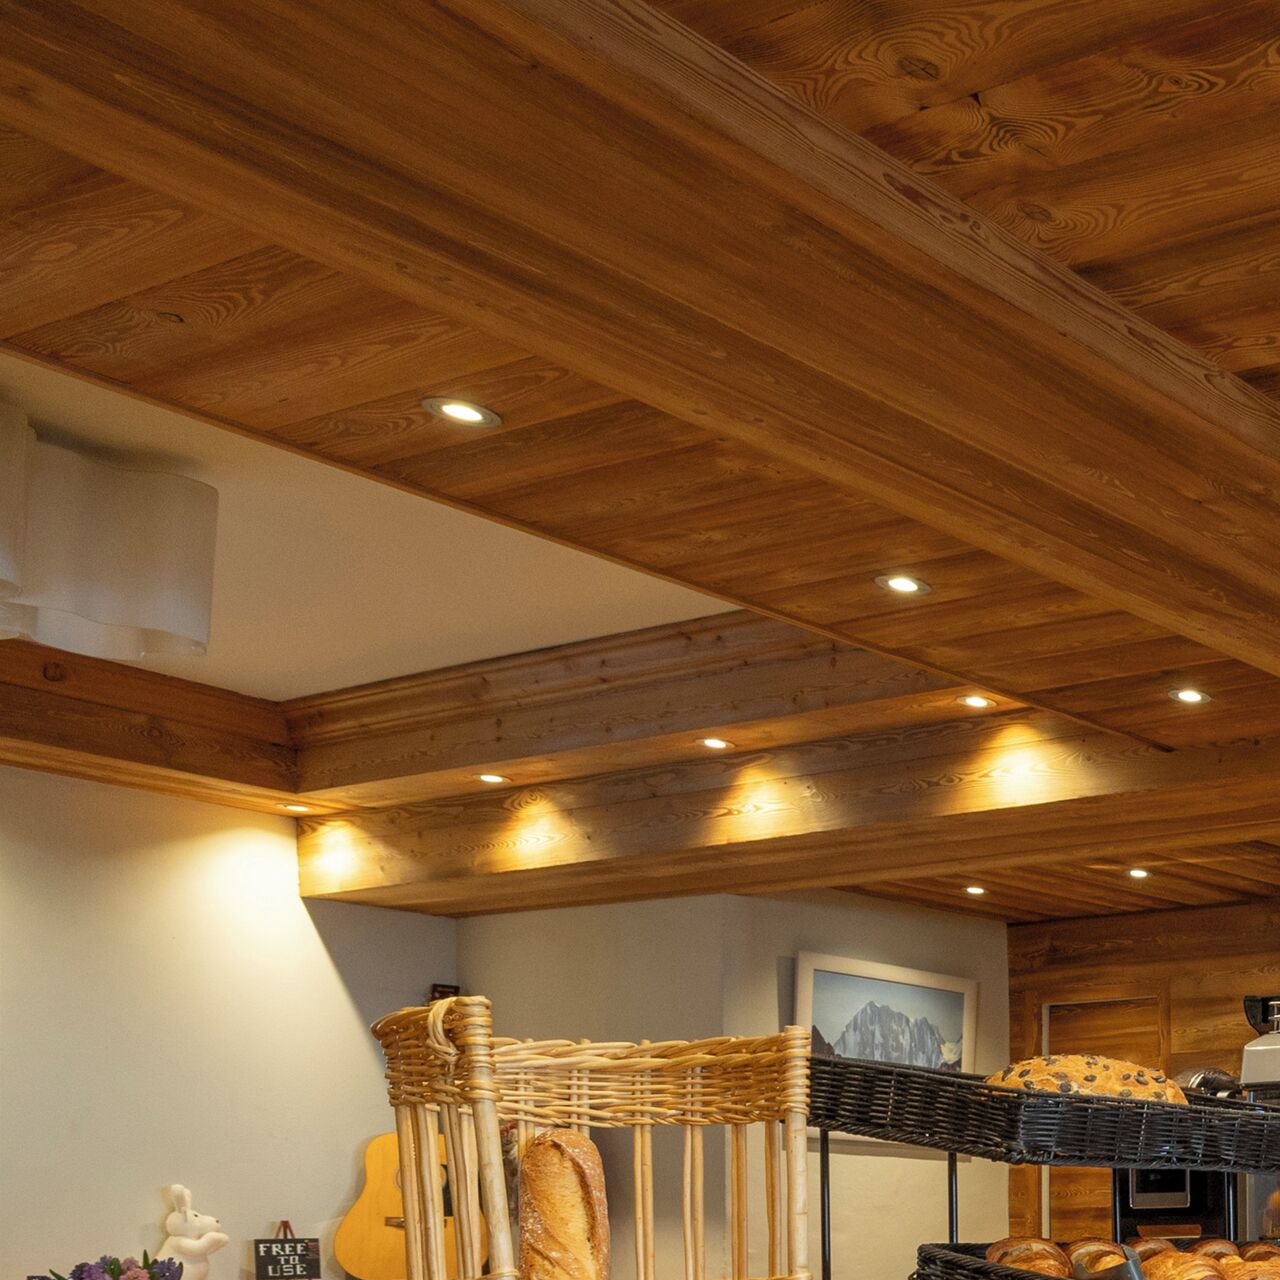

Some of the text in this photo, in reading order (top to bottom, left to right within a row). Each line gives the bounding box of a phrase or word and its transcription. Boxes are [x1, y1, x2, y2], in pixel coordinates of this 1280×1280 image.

[258, 1243, 307, 1256] FREE
[277, 1255, 300, 1264] TO
[268, 1264, 307, 1276] USE
